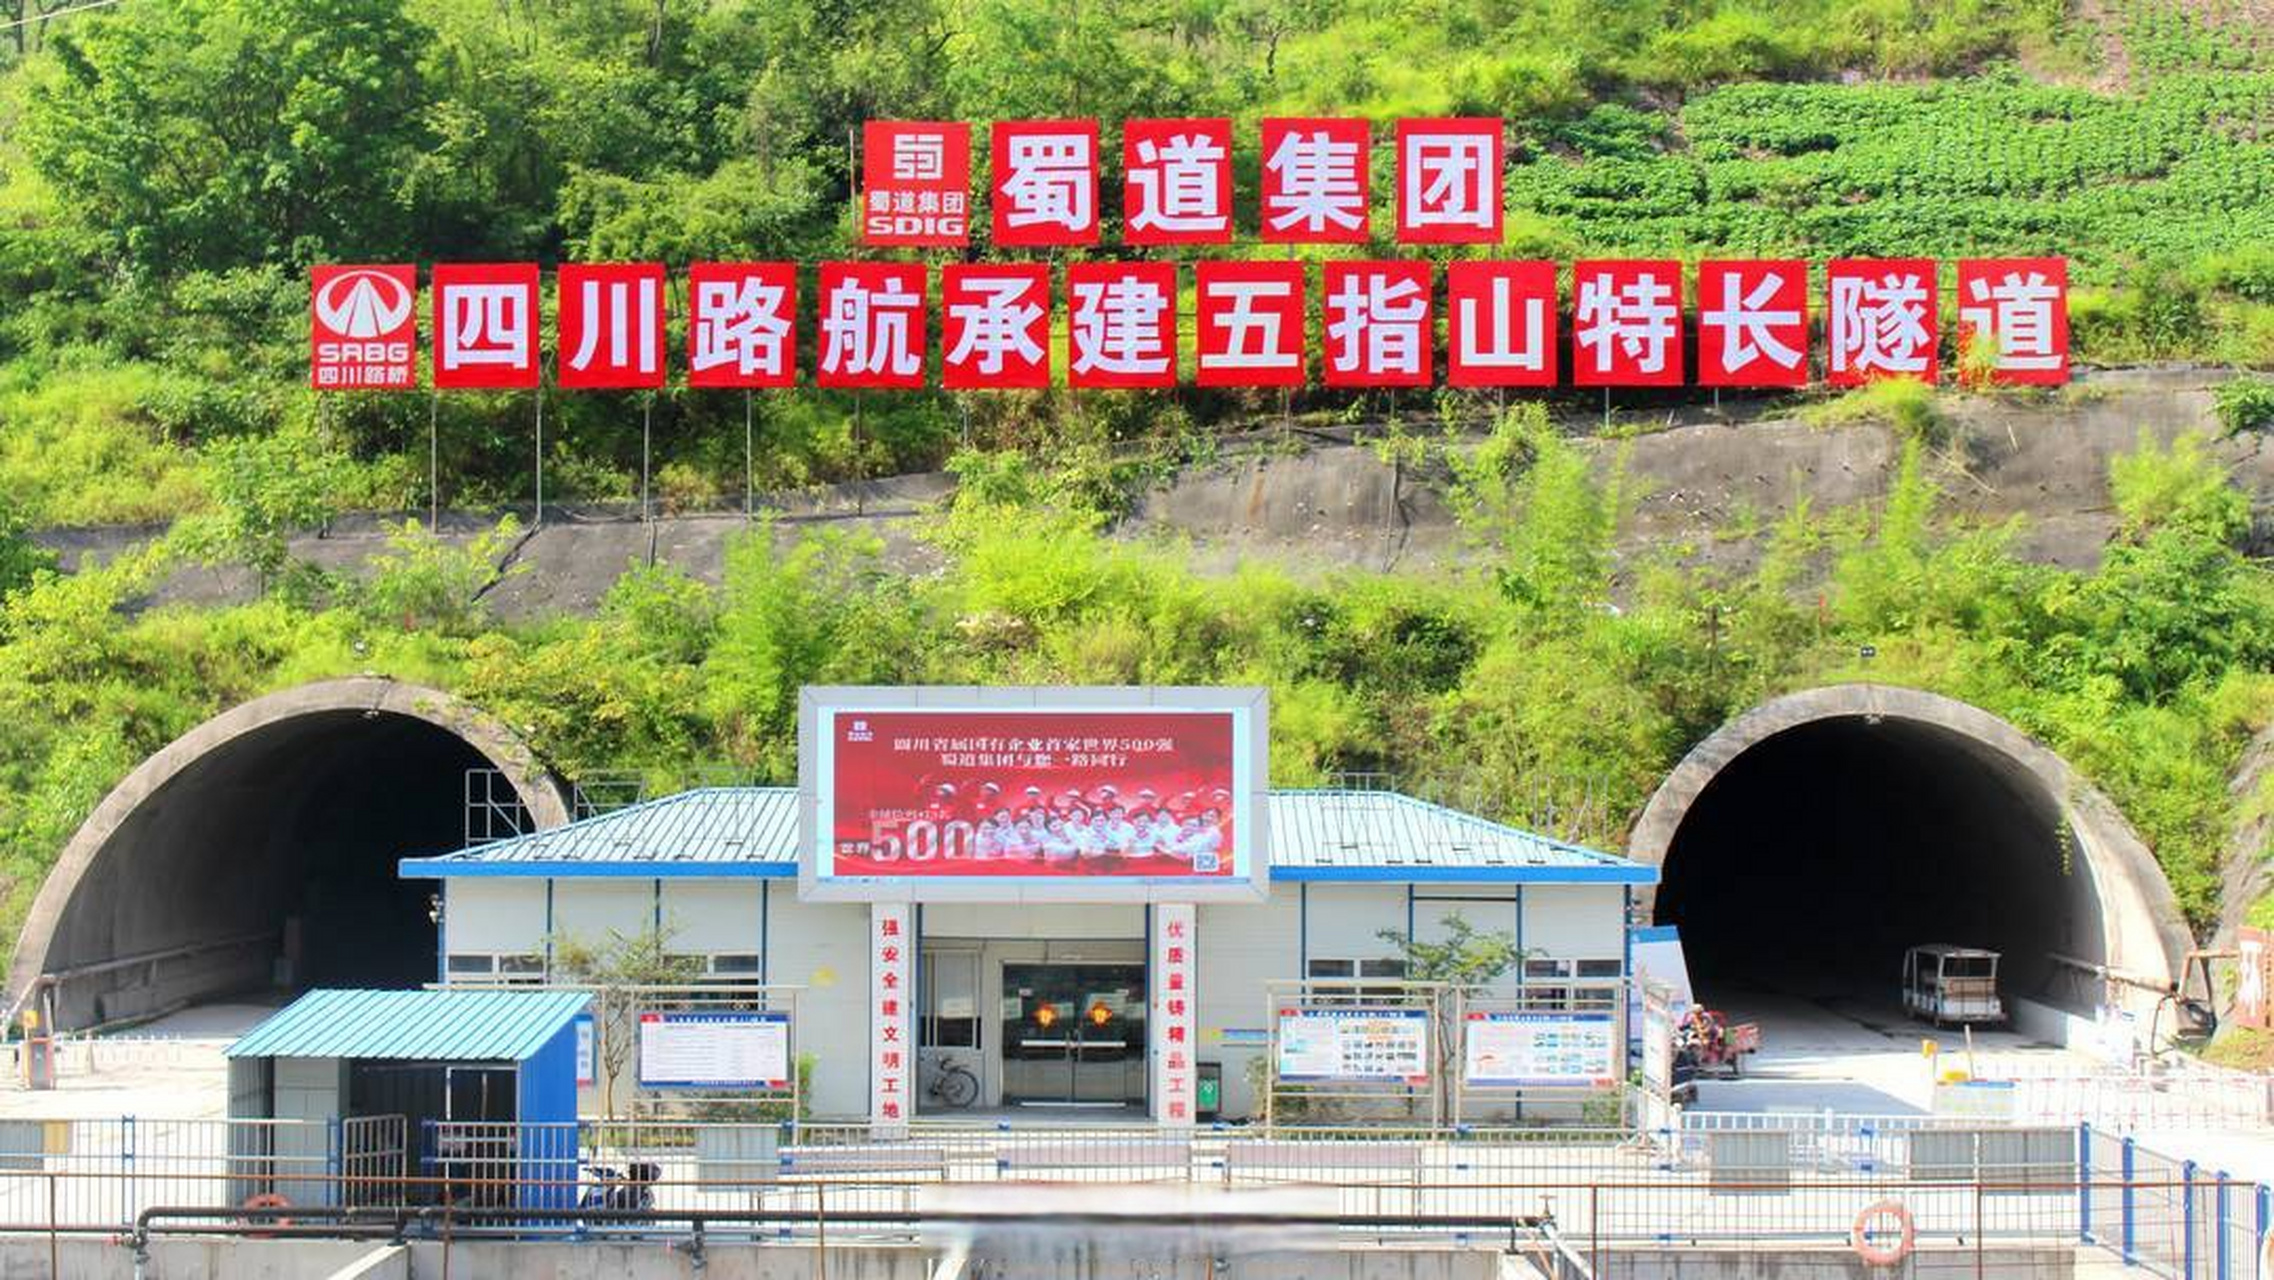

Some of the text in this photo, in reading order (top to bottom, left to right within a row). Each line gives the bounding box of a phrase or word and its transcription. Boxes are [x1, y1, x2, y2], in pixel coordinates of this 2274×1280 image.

[869, 191, 965, 213] 蜀道集团
[1001, 131, 1495, 232] 蜀道集团
[866, 216, 964, 235] SDIG
[317, 342, 409, 363] SABG
[443, 272, 2063, 375] 四川路航承建五指山特长隧道
[317, 366, 409, 385] 四川路桥
[881, 918, 900, 1120] 强安全建文明工地
[1167, 920, 1186, 1119] 优质量铸精品工程
